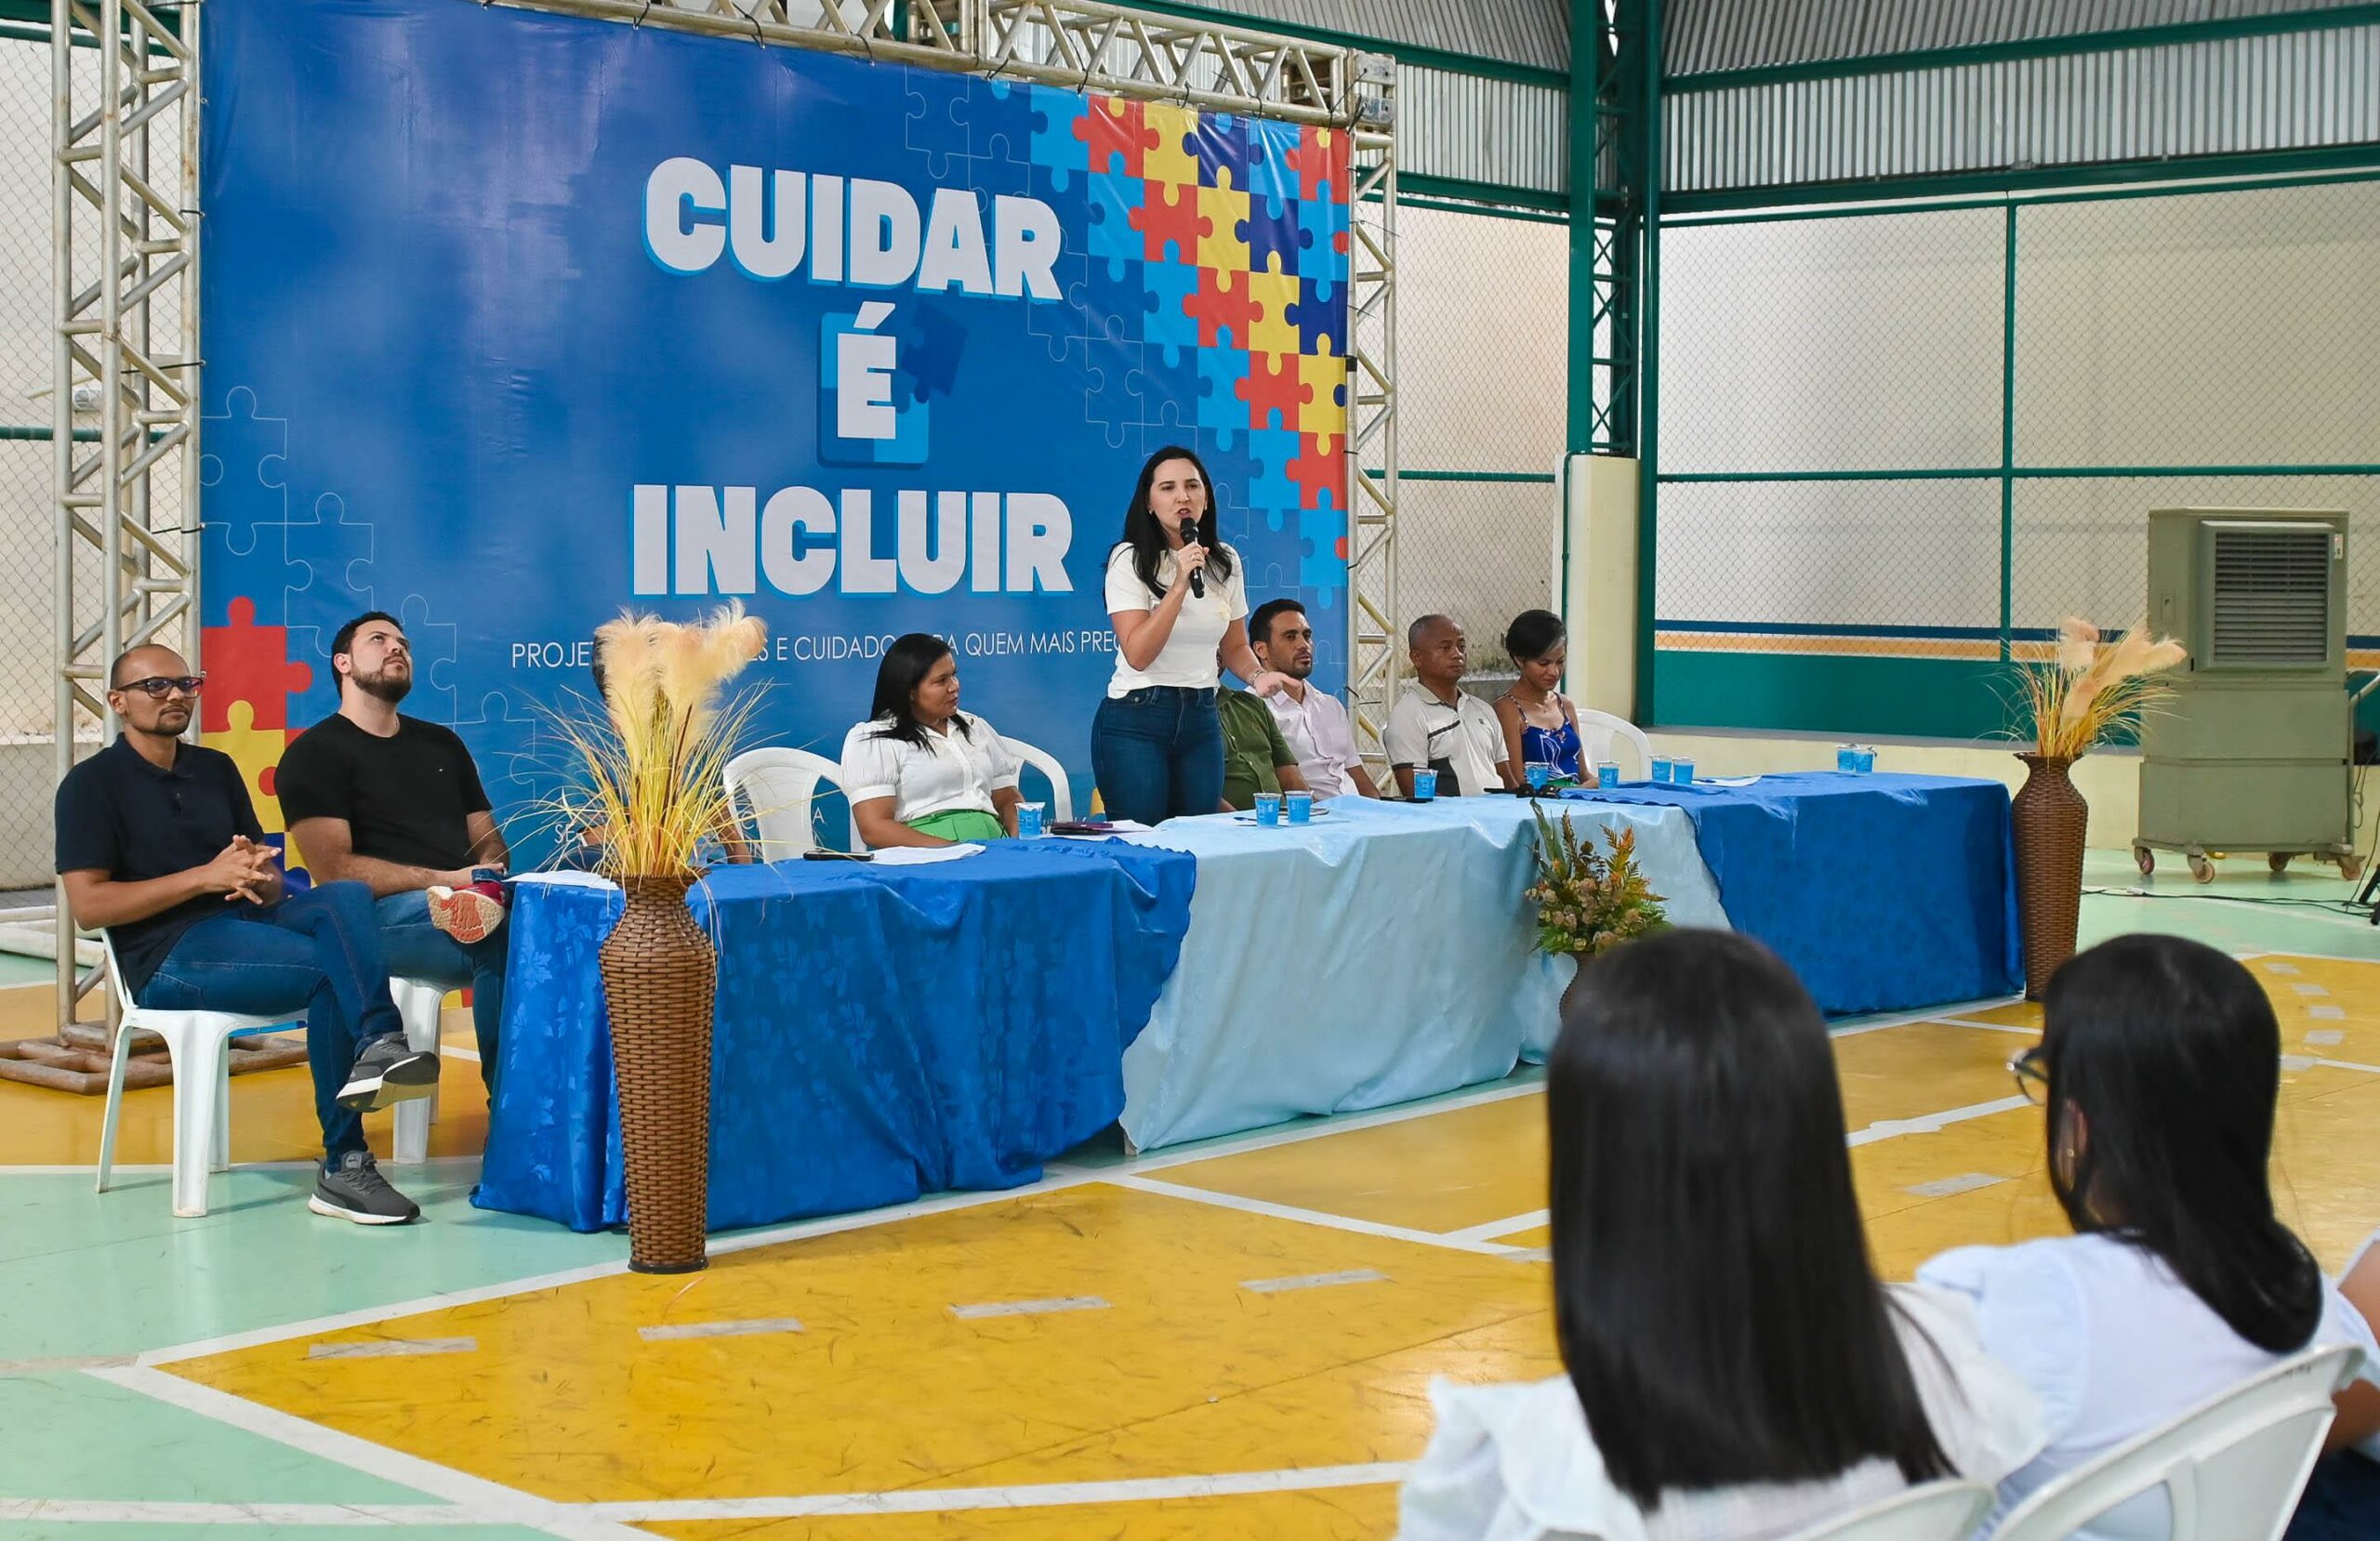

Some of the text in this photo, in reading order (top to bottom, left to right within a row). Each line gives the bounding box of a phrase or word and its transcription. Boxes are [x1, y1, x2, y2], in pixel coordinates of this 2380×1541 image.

[642, 156, 1064, 301] CUIDAR
[837, 300, 896, 440] É
[631, 483, 1075, 596] INCLUIR
[511, 641, 594, 668] PROJE
[776, 637, 788, 661] E
[965, 631, 1025, 657] QUEM
[1029, 631, 1076, 654] MAIS
